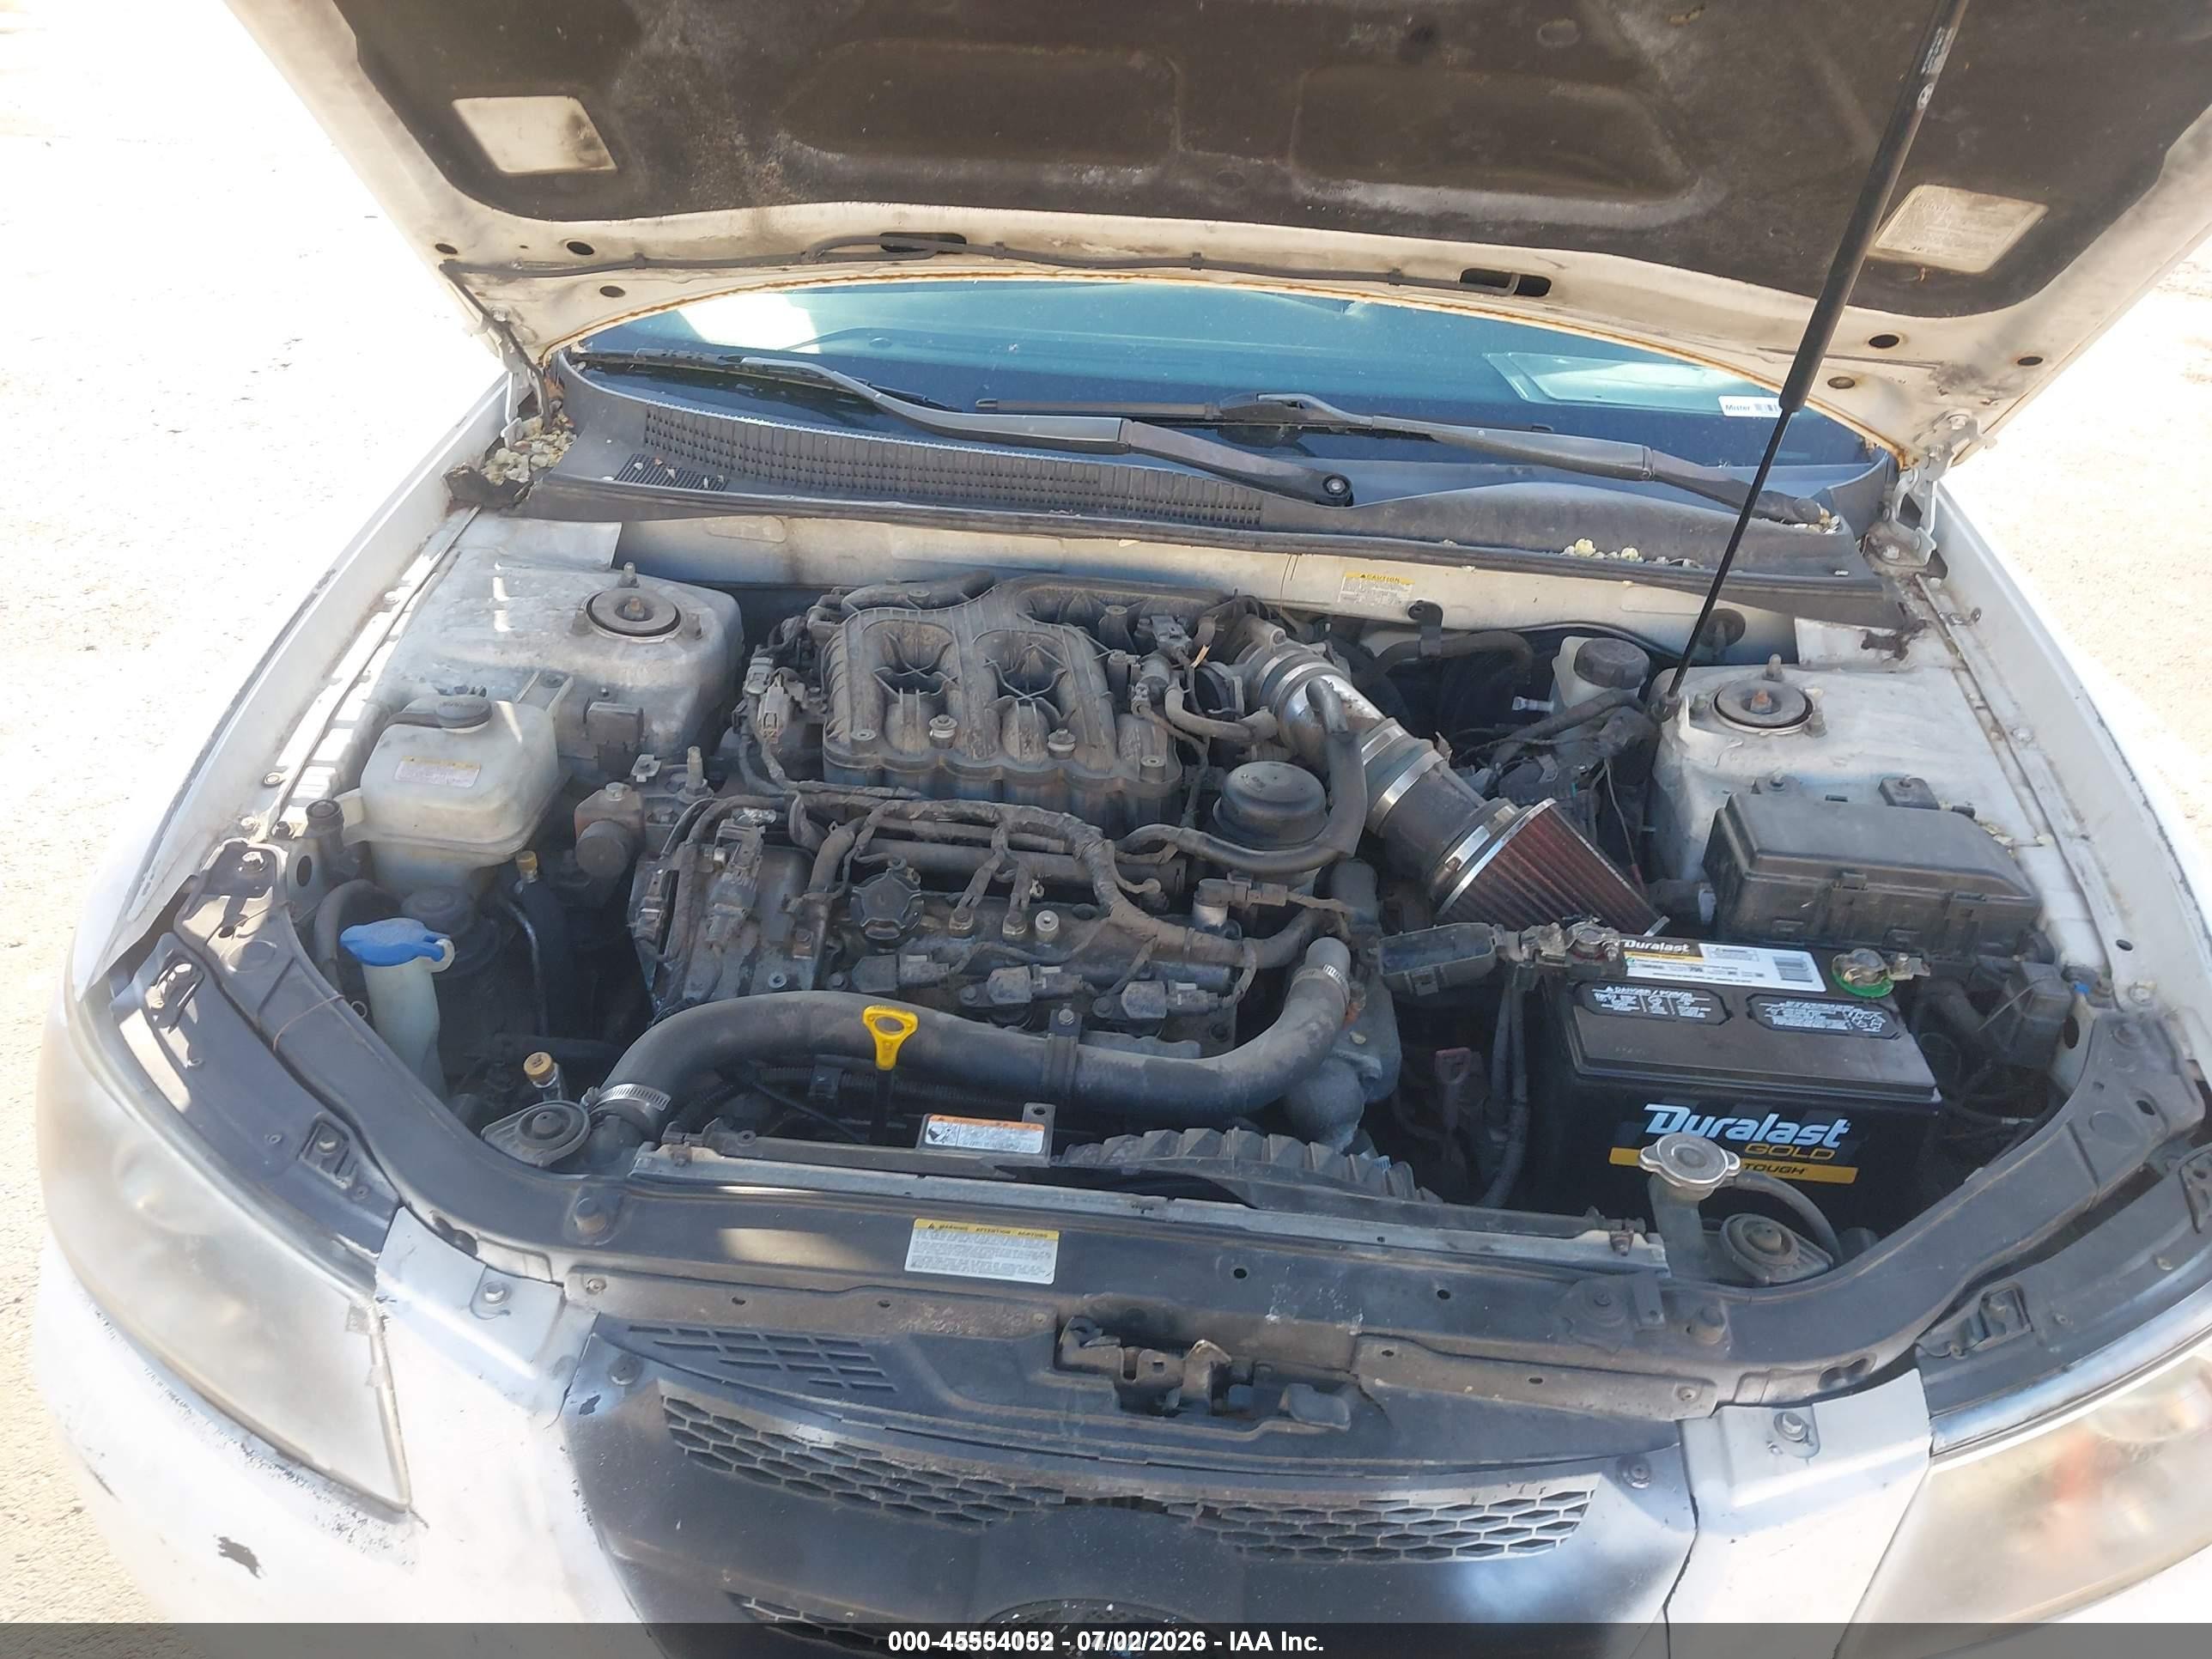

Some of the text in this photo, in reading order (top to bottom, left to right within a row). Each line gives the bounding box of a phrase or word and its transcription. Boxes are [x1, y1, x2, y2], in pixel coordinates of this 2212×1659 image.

[1366, 574, 1401, 583] CAUTION
[1620, 939, 1691, 953] Duralast
[1644, 1103, 1850, 1149] Duralast
[1744, 1143, 1837, 1161] GOLD
[1744, 1162, 1807, 1176] TOUGH
